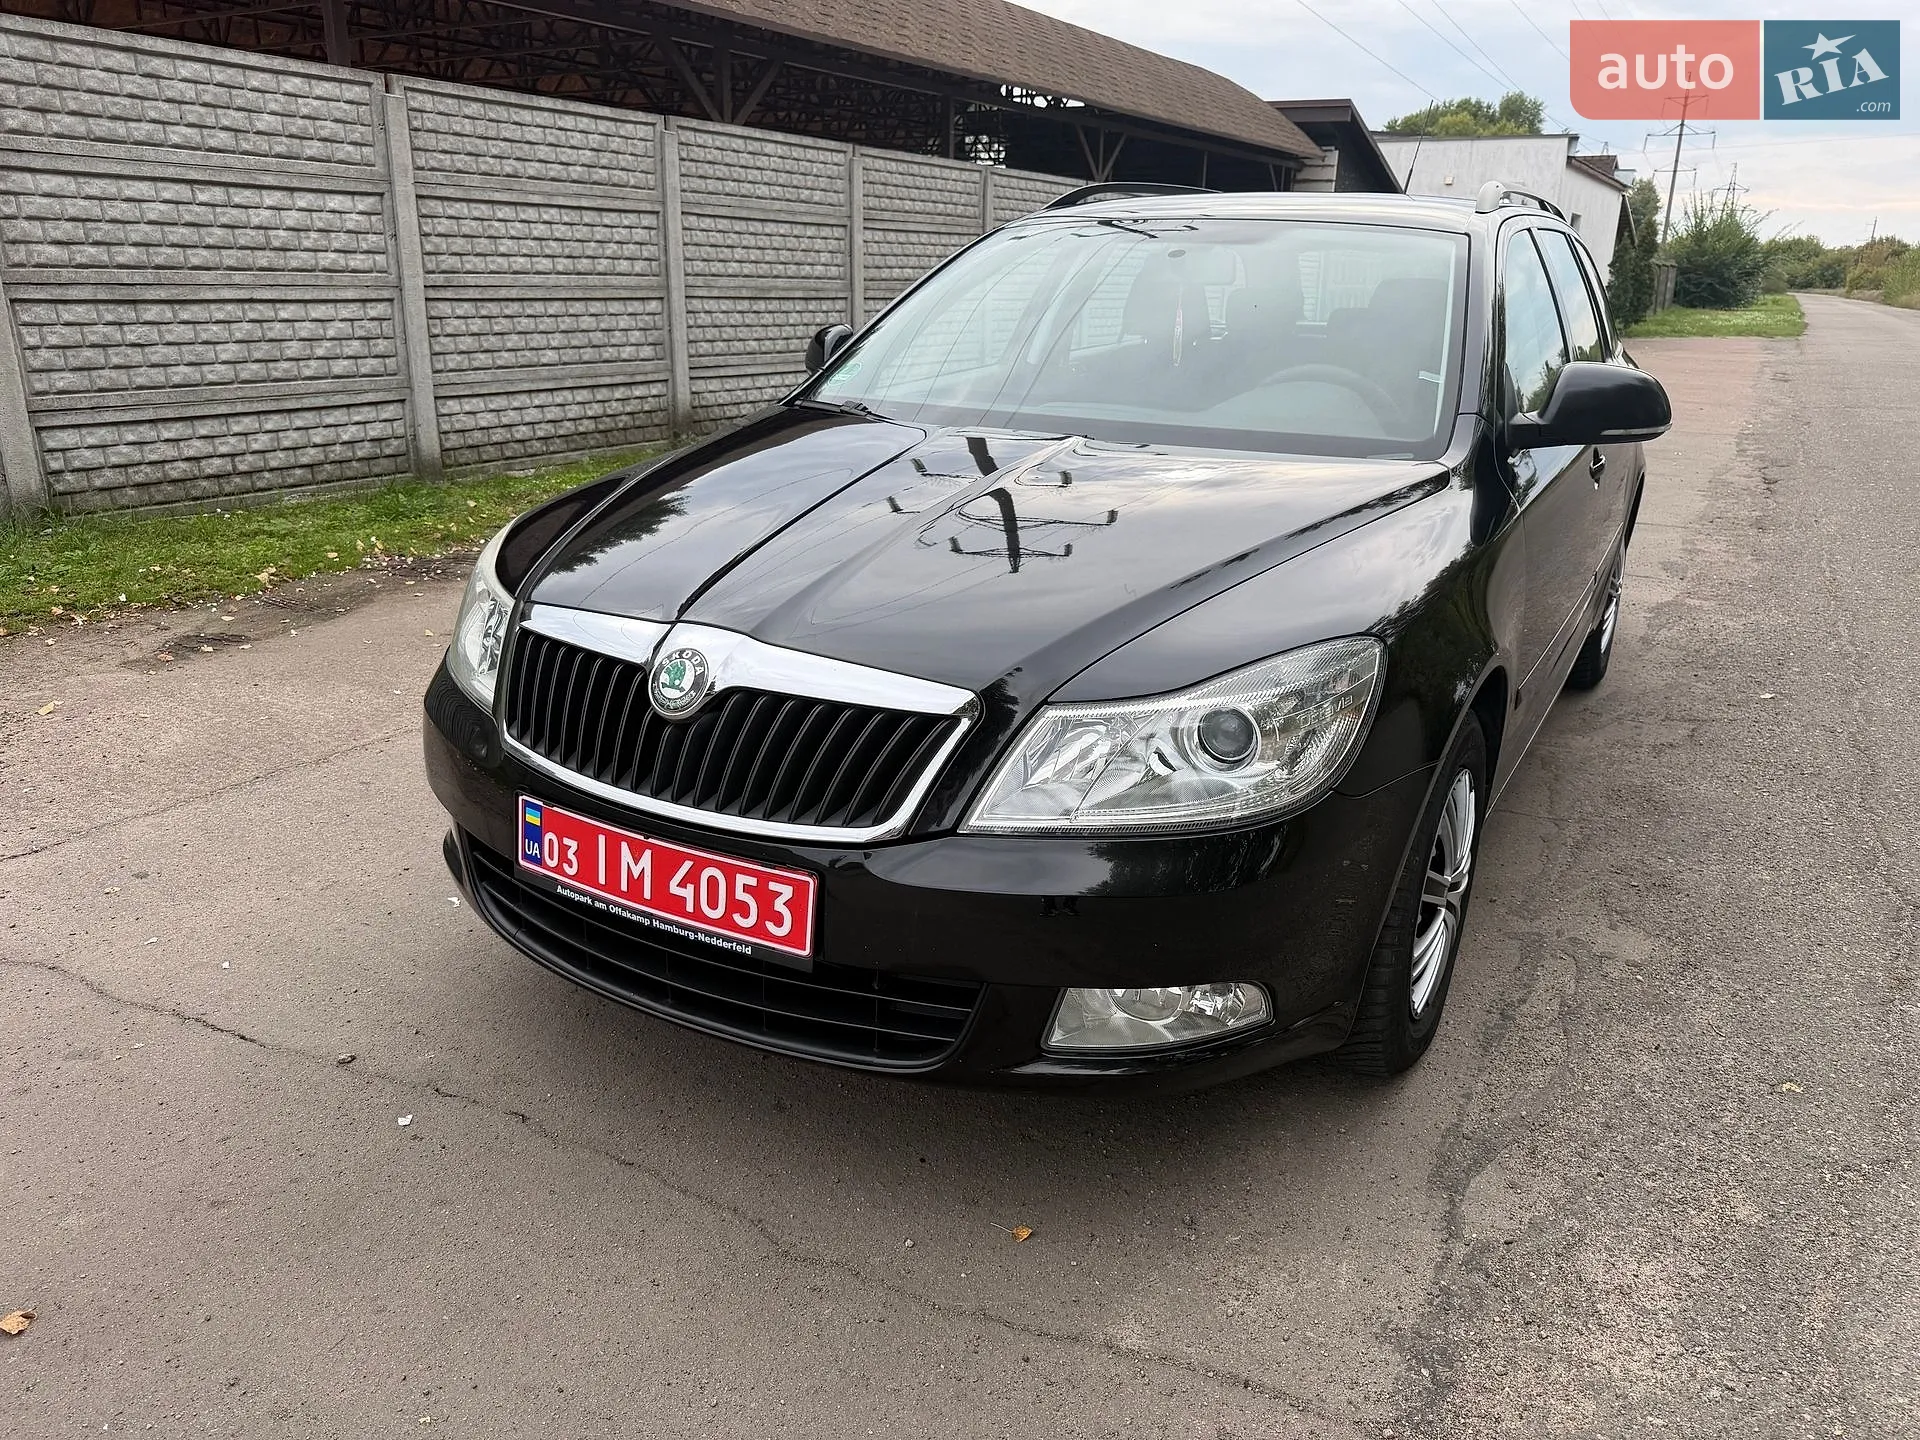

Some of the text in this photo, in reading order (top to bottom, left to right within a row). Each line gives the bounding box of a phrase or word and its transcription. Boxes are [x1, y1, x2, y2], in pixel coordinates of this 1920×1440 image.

[525, 838, 541, 859] UA
[544, 831, 579, 876] 03
[669, 860, 794, 937] 4053
[556, 885, 593, 905] Autopark
[594, 900, 608, 911] am
[652, 918, 752, 955] Hamburg-Nedderfeld
